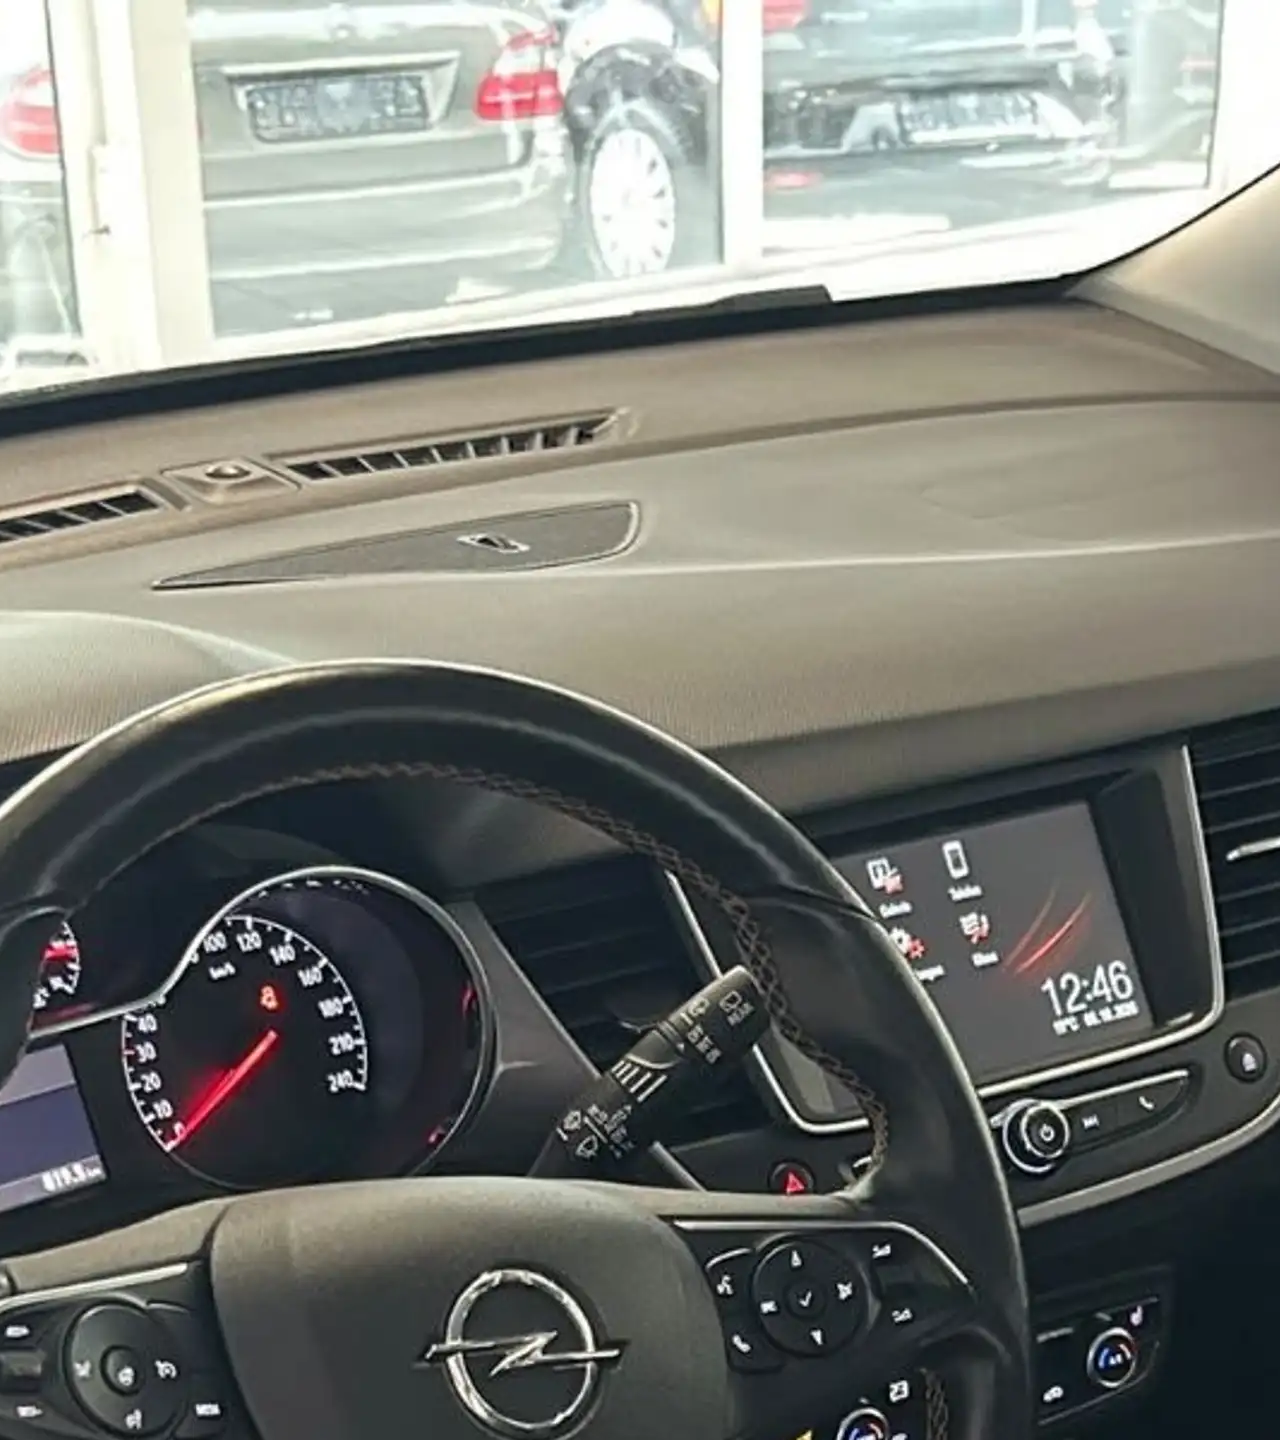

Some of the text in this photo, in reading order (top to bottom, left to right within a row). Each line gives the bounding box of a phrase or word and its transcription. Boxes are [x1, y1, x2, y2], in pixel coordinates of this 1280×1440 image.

[236, 931, 262, 953] 120
[270, 944, 296, 966] 140
[297, 965, 322, 987] 160
[1040, 959, 1133, 1016] 12:46
[140, 1071, 162, 1093] 20
[327, 1069, 354, 1093] 240
